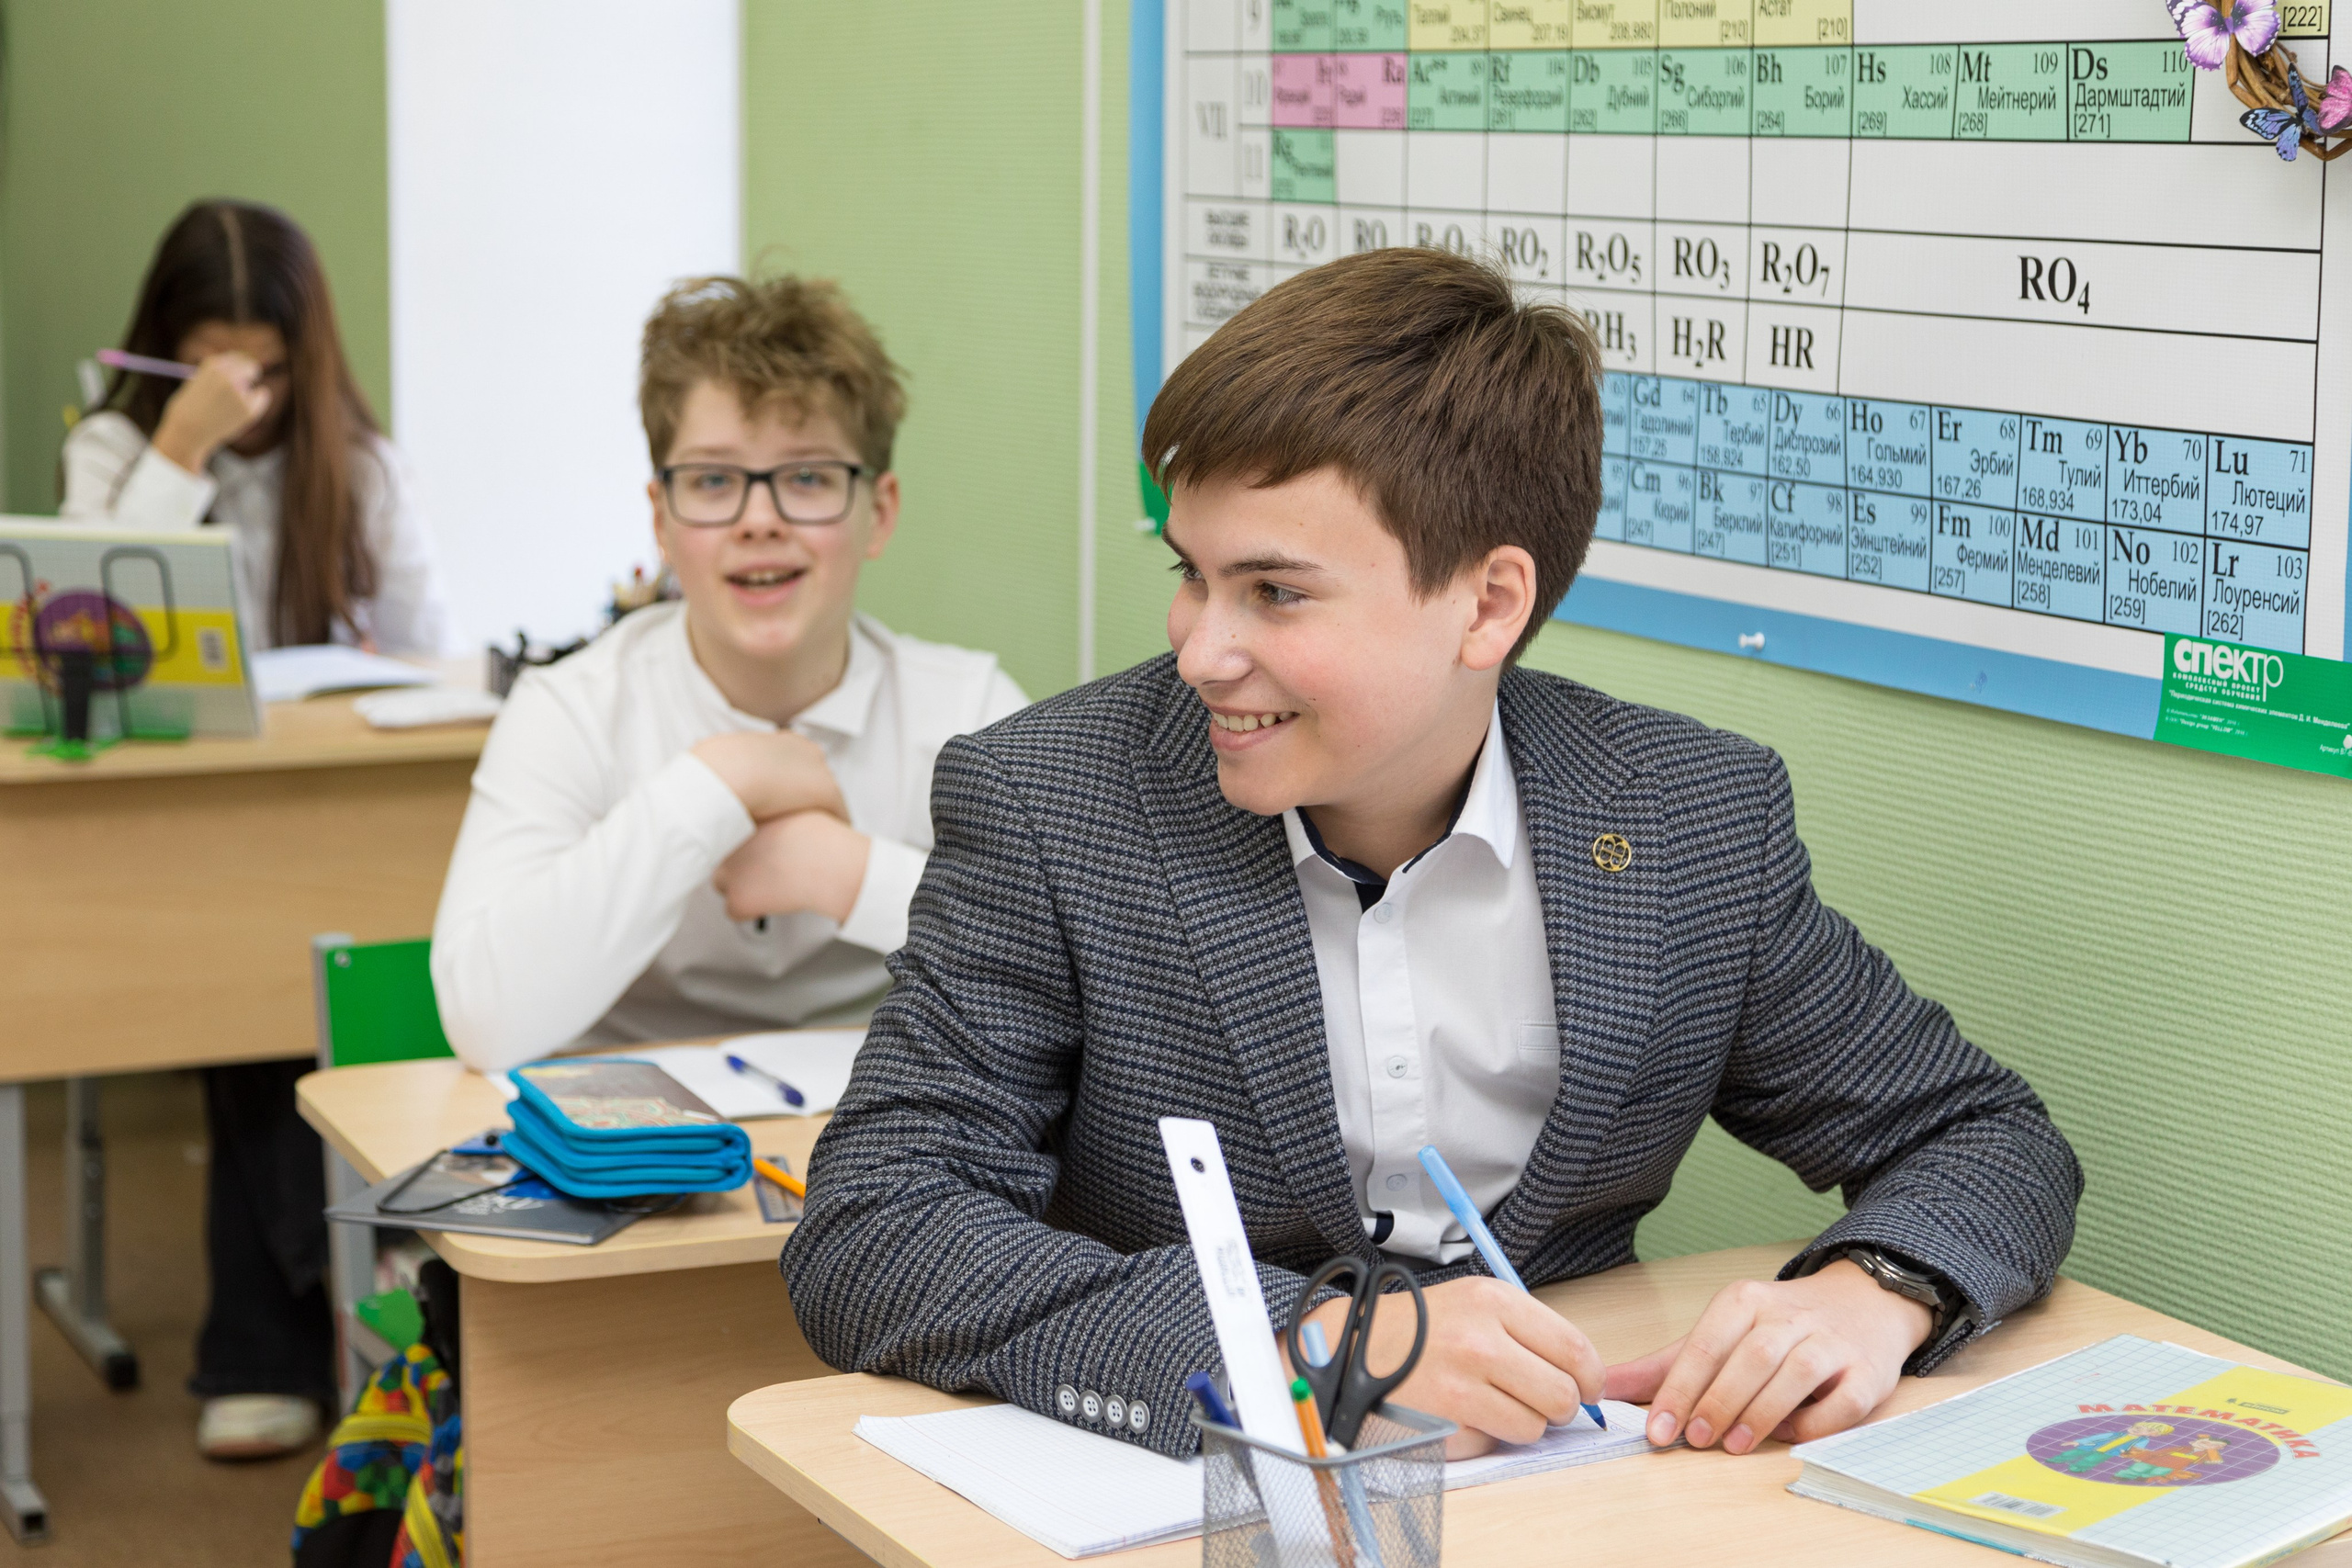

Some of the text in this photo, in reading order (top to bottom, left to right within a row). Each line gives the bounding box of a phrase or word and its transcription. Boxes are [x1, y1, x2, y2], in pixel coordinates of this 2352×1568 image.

[1817, 17, 1848, 41] [210]
[2283, 6, 2323, 32] [222]
[1574, 55, 1600, 84] Db
[1660, 54, 1747, 94] Sg 106
[1756, 53, 1848, 84] Bh 107
[1857, 52, 1952, 84] Hs 108
[1961, 52, 2058, 83] Mt 109
[2071, 48, 2188, 81] Ds 110
[1687, 85, 1746, 112] Сиборгий
[1804, 85, 1845, 115] Борий
[1902, 85, 1949, 110] Хассий
[1977, 85, 2057, 116] Мейтнерий
[2075, 83, 2186, 112] Дармштадтий
[1661, 109, 1689, 134] [266]
[1757, 111, 1785, 135] [264]
[1858, 111, 1887, 137] [269]
[1958, 111, 1987, 137] [268]
[2074, 113, 2111, 138] [271]
[1770, 324, 1815, 369] HR
[1634, 376, 1662, 408] Gd
[1703, 383, 1767, 415] Tb 65
[1634, 409, 1694, 437] Гадолиний
[1775, 393, 1841, 431] Dy 66
[1851, 401, 1927, 434] Ho 67
[1938, 410, 2017, 443] Er 68
[1723, 419, 1765, 447] Тербий
[1774, 427, 1842, 457] Диспрозий
[2027, 419, 2103, 456] Tm 69
[2114, 429, 2201, 465] Yb 70
[1867, 436, 1928, 467] Гольмий
[1971, 448, 2014, 479] Эрбий
[2215, 439, 2307, 476] Lu 71
[1631, 461, 1692, 493] Cm 96
[1771, 457, 1812, 479] 162,50
[1851, 465, 1903, 490] 164,930
[2058, 459, 2102, 491] Тулий
[1700, 470, 1764, 503] Bk 97
[1771, 481, 1842, 514] Cf 98
[1937, 474, 1983, 501] 167,26
[2022, 486, 2075, 512] 168,934
[2124, 468, 2200, 502] Иттербий
[2233, 479, 2306, 518] Лютеций
[1654, 498, 1690, 525] Кюрий
[1714, 508, 1764, 536] Берклий
[1853, 493, 1928, 525] Es 99
[1938, 505, 2011, 539] Fm 100
[2112, 499, 2163, 525] 173,04
[2212, 510, 2265, 537] 174,97
[1699, 527, 1725, 556] [247]
[1770, 515, 1844, 548] Калифорний
[1851, 526, 1928, 559] Эйнштейний
[2020, 516, 2099, 553] Md 101
[1771, 543, 1803, 569] [251]
[1957, 542, 2008, 574] Фермий
[2112, 529, 2199, 566] No 102
[2211, 542, 2303, 580] Lr 103
[1851, 553, 1883, 580] [252]
[1934, 564, 1966, 595] [257]
[2018, 551, 2101, 586] Менделевий
[2017, 581, 2051, 610] [258]
[2128, 568, 2197, 603] Нобелий
[2213, 579, 2301, 615] Лоуренсий
[2109, 595, 2146, 626] [259]
[2207, 610, 2245, 642] [262]
[2186, 682, 2260, 701] СРЕДСТВ ОБУЧЕНИЯ
[2232, 682, 2261, 694] ПРОЕКТ
[2076, 1404, 2321, 1459] МАТЕМАТИКА
